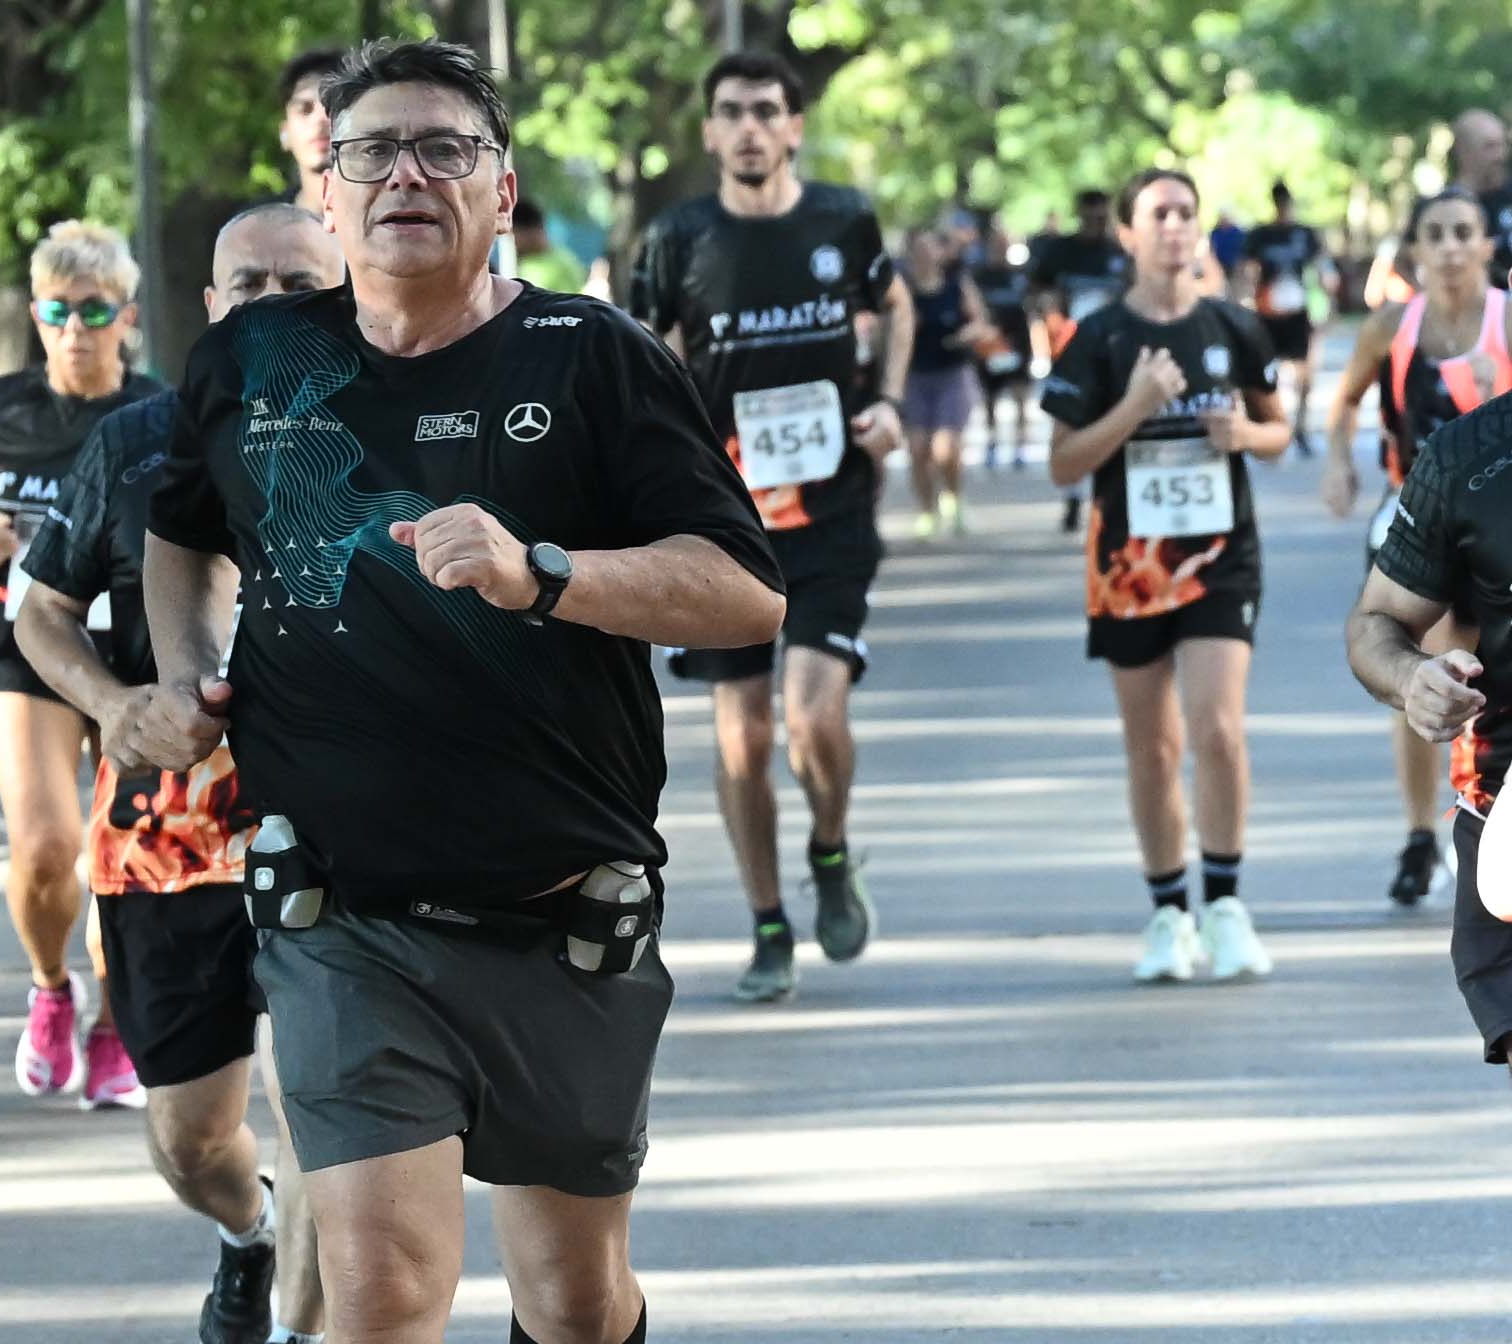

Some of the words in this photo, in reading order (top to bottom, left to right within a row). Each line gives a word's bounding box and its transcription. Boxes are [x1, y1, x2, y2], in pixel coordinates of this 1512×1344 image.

[248, 415, 344, 433] Mercedes-Benz
[419, 423, 474, 439] MOTORS
[752, 417, 828, 457] 454
[1140, 473, 1215, 506] 453
